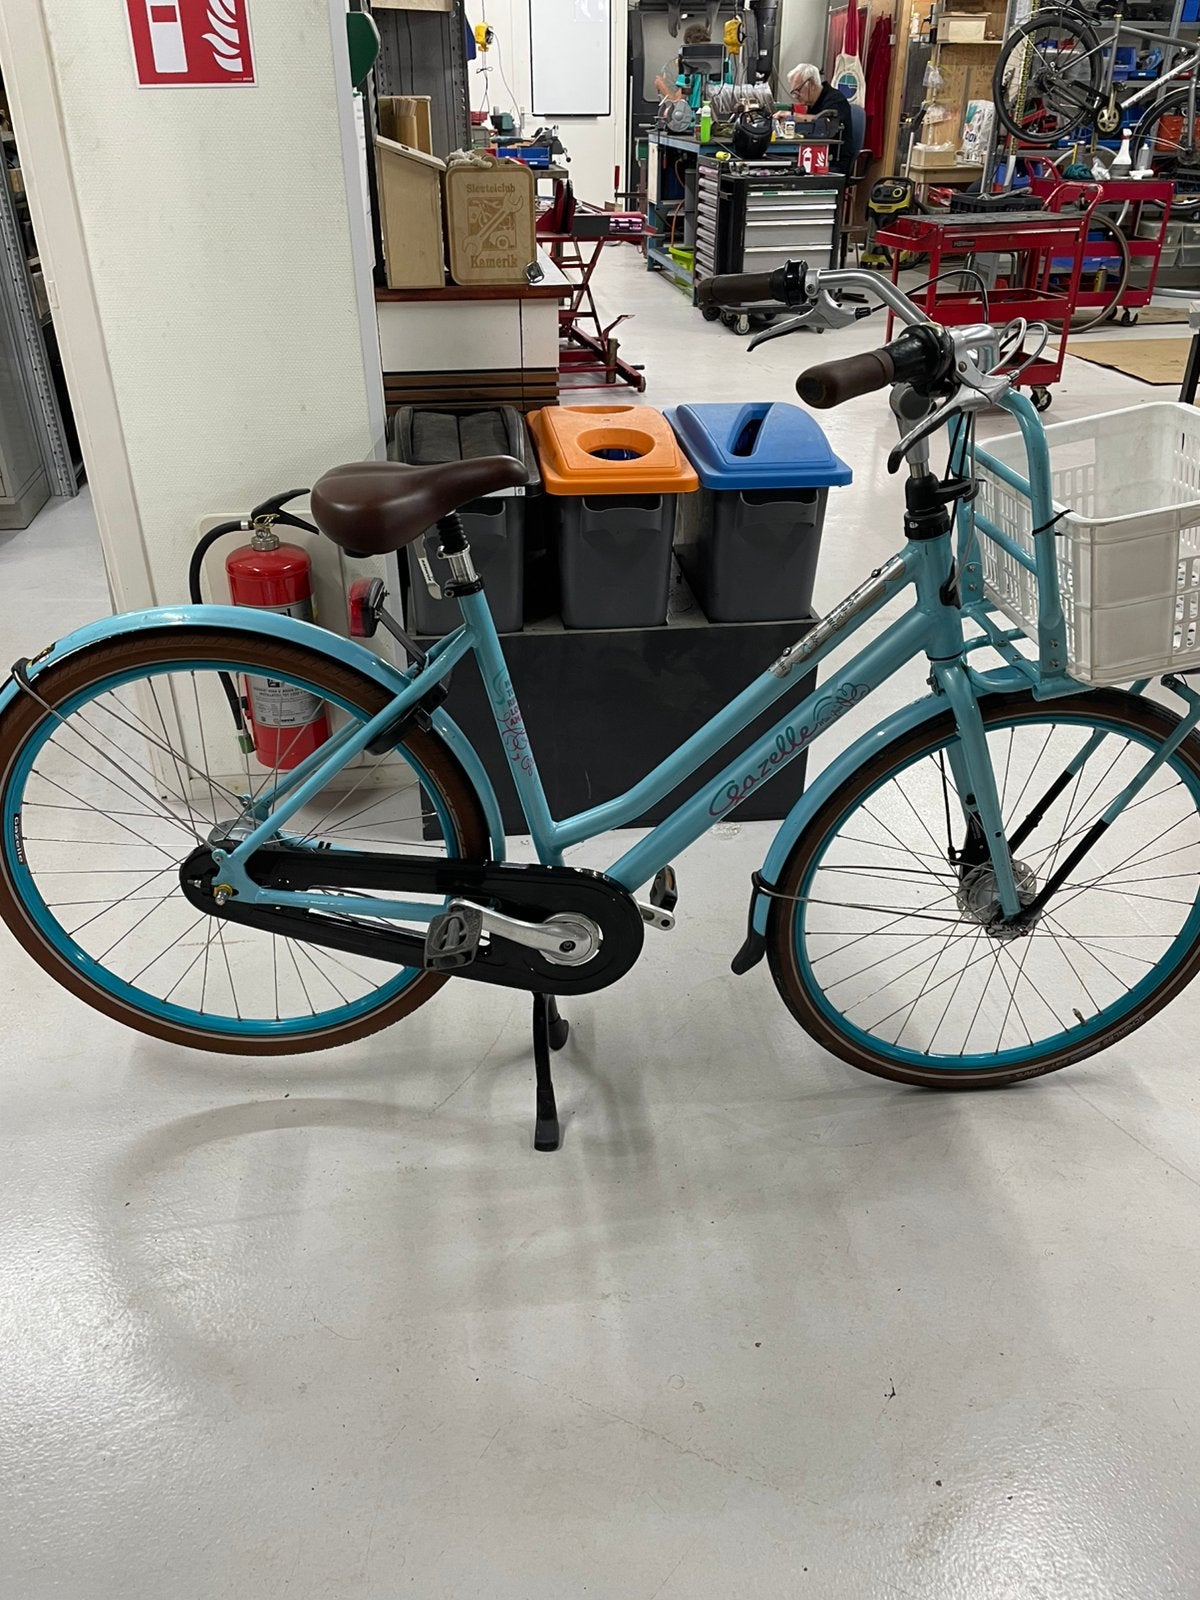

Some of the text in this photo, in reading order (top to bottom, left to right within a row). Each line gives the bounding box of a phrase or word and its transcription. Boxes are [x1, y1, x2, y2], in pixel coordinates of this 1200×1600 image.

[466, 183, 516, 193] Sleutelclub
[470, 254, 519, 268] Kamerik
[709, 723, 817, 816] Gazelle
